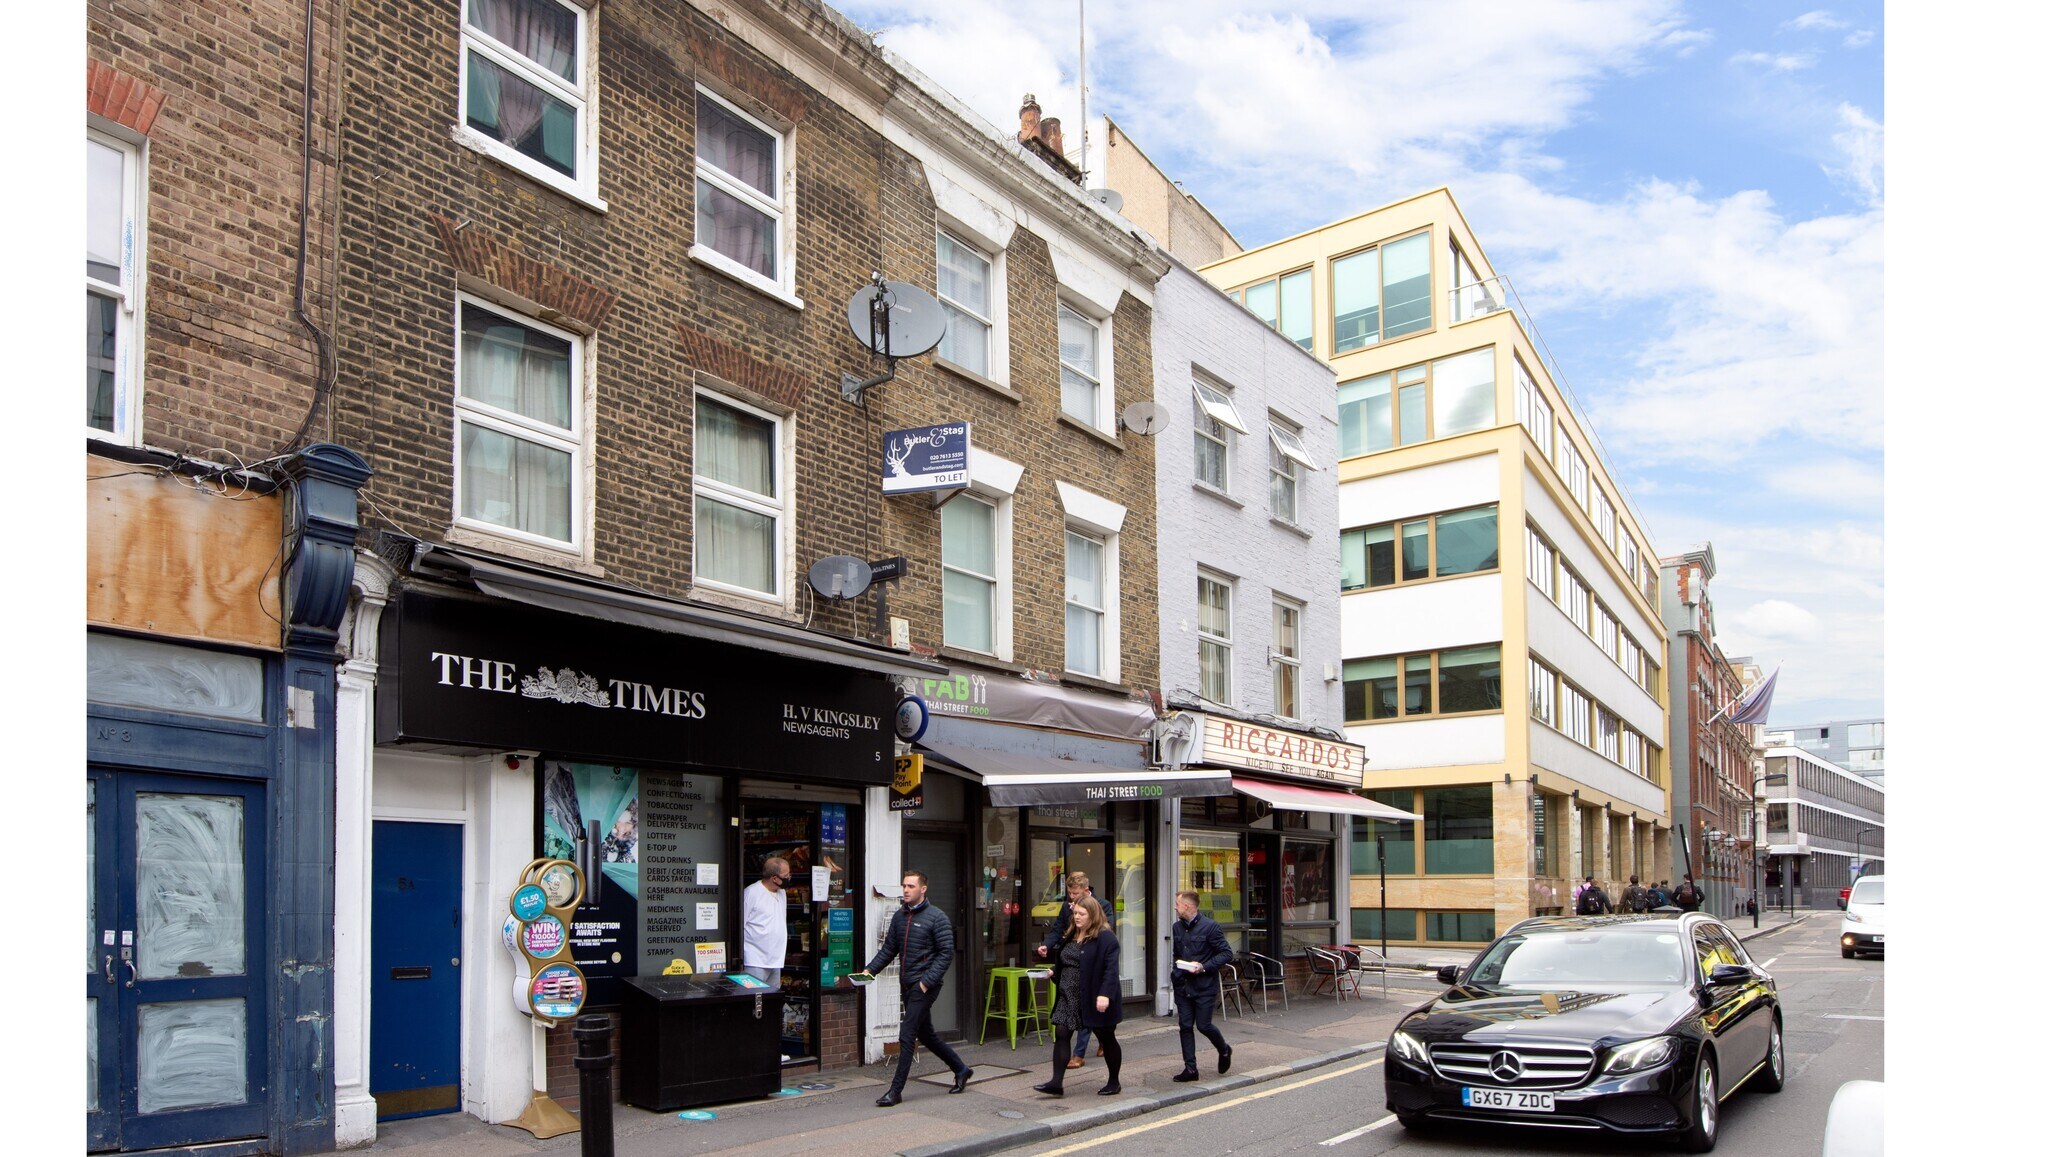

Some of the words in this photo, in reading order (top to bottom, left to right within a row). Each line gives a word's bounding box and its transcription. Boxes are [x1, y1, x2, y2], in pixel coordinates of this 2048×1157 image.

[904, 435, 930, 445] Butler
[943, 426, 964, 436] Stag
[923, 463, 964, 472] butlerandstag.com
[934, 474, 946, 483] TO
[948, 472, 963, 482] LET
[432, 652, 516, 694] THE
[609, 678, 706, 720] TIMES
[924, 674, 970, 700] FAB
[925, 701, 942, 710] THAI
[944, 703, 968, 714] STREET
[970, 706, 990, 716] FOOD
[783, 704, 798, 719] H.
[800, 706, 811, 720] V
[814, 708, 881, 730] KINGSLEY
[121, 728, 131, 742] 3
[783, 721, 850, 739] NEWSAGENTS
[1223, 722, 1352, 770] RICCARDOS
[875, 752, 880, 761] 5
[1246, 757, 1262, 770] NICE
[1265, 760, 1274, 770] TO
[1281, 763, 1293, 774] SEE
[1300, 766, 1311, 777] YOU
[1316, 770, 1335, 780] AGAIN
[647, 777, 692, 788] NEWSAGENTS
[647, 790, 701, 800] CONFECTIONERS
[1086, 788, 1106, 799] THAI
[1109, 786, 1138, 798] STREET
[1140, 785, 1163, 796] FOOD
[647, 801, 693, 811] TOBACCONIST
[647, 813, 687, 822] NEWSPAPER
[1038, 805, 1053, 817] thai
[1056, 806, 1078, 818] street
[1080, 808, 1097, 819] food
[647, 820, 679, 828] DELIVERY
[681, 822, 706, 830] SERVICE
[647, 832, 676, 840] LOTTERY
[520, 894, 539, 905] £1.50
[532, 923, 556, 934] WIN
[575, 922, 620, 930] SATISFACTION
[647, 936, 684, 944] GREETINGS
[1473, 1091, 1513, 1106] GX67
[1518, 1094, 1551, 1108] ZDC
